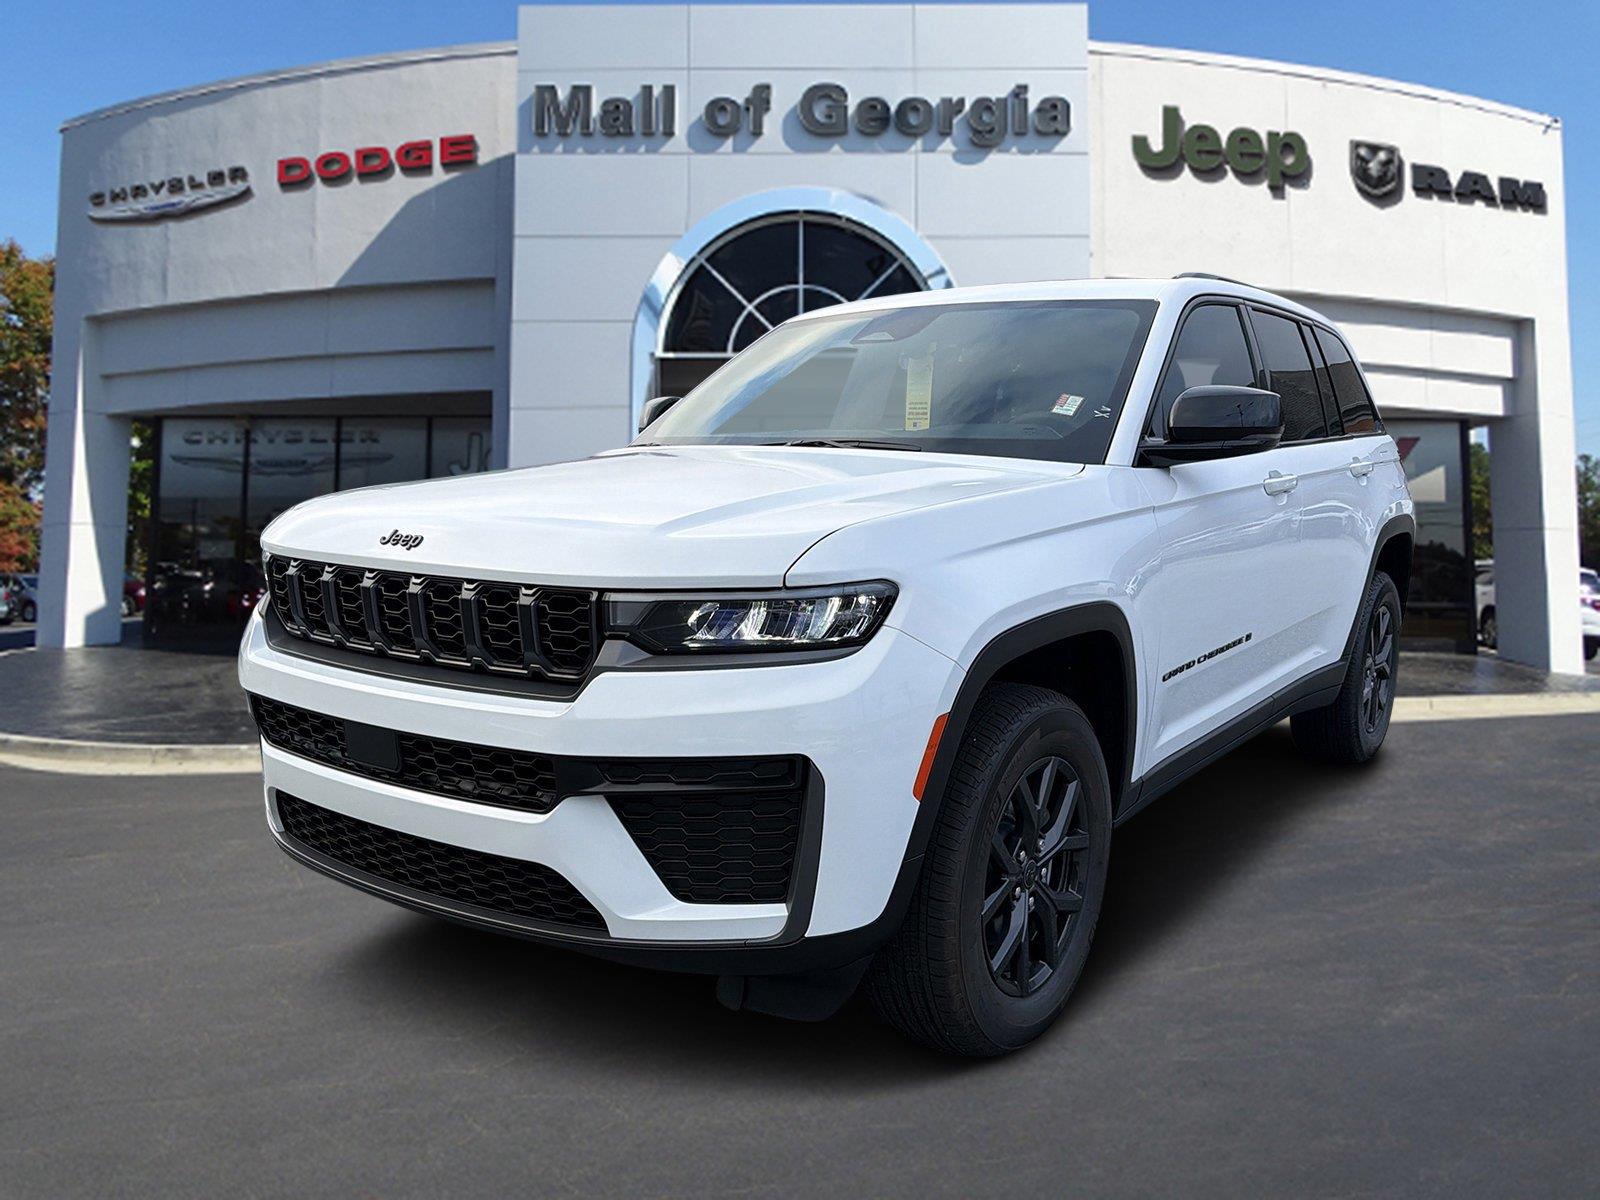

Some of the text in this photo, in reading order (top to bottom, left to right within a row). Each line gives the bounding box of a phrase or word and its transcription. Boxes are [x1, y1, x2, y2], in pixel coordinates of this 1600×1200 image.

[531, 83, 1072, 147] Mall of Georgia
[277, 134, 477, 185] DODGE
[1132, 105, 1310, 190] Jeep
[89, 166, 249, 207] CHRYSLER
[1411, 162, 1547, 214] RAM
[380, 529, 424, 551] Jeep
[1162, 636, 1245, 683] GRAND CHEROKEE
